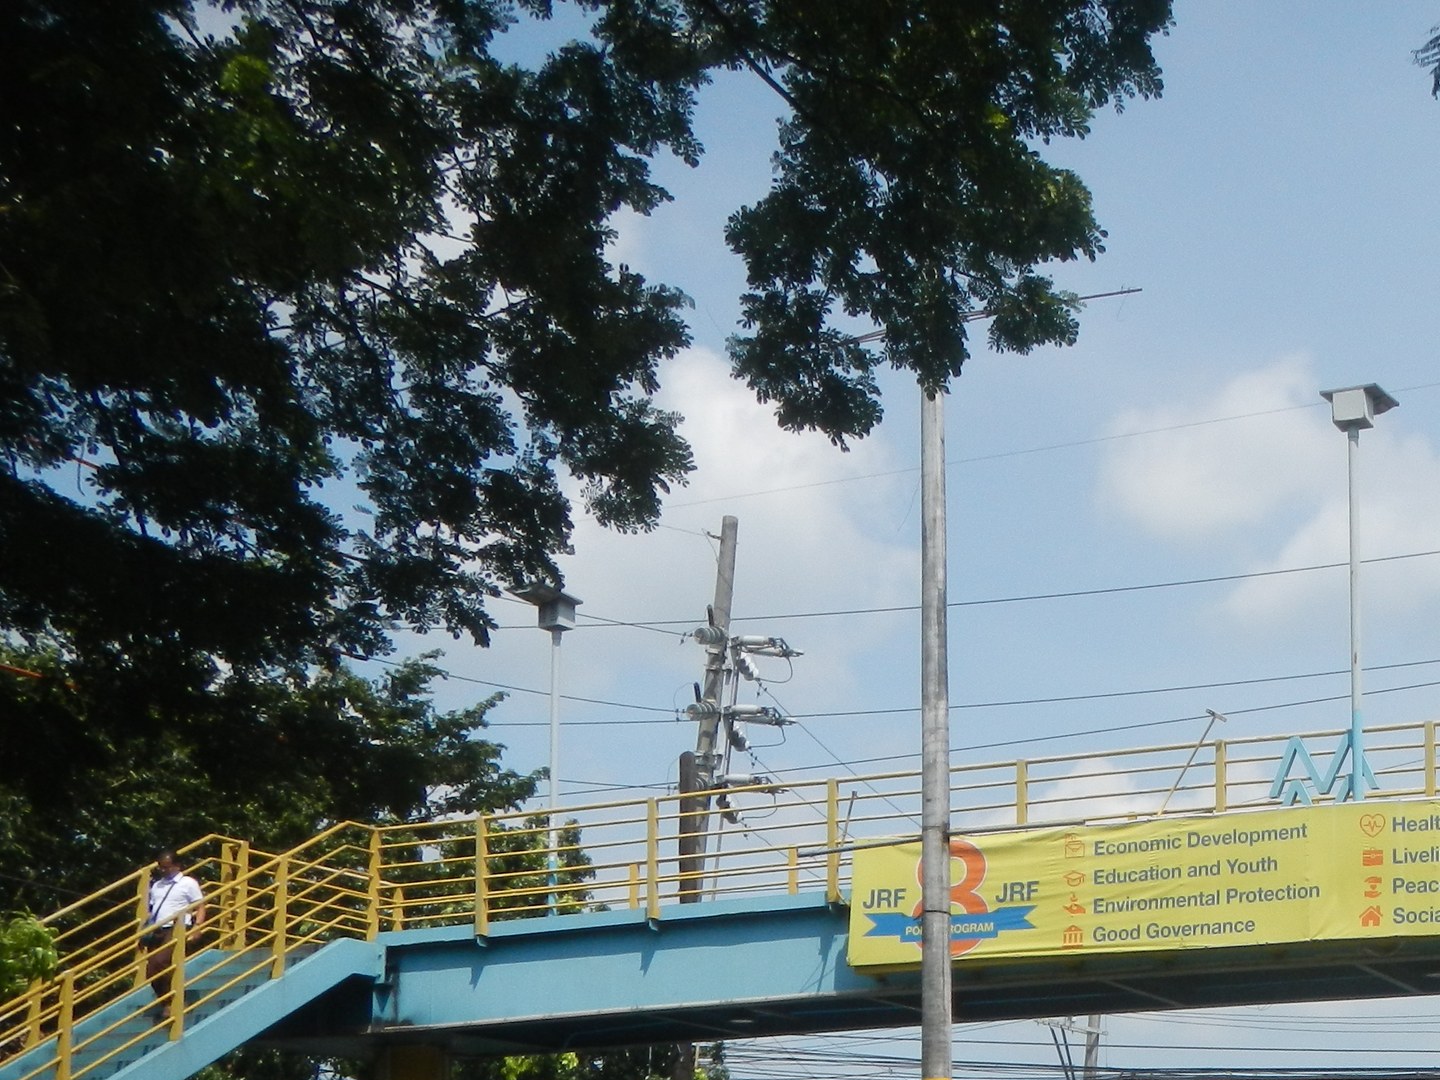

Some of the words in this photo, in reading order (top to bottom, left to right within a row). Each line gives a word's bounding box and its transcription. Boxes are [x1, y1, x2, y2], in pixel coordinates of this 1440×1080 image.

[1094, 835, 1181, 856] Economic
[1187, 823, 1307, 848] Development
[1093, 865, 1181, 885] Education
[1187, 861, 1221, 877] and
[1226, 856, 1278, 874] Youth
[862, 888, 907, 909] JRF
[995, 880, 1040, 903] JRF
[1093, 889, 1220, 914] Environmental
[1226, 884, 1320, 904] Protection
[950, 922, 994, 934] OGRAM
[1093, 924, 1140, 942] Good
[1146, 919, 1255, 939] Governance
